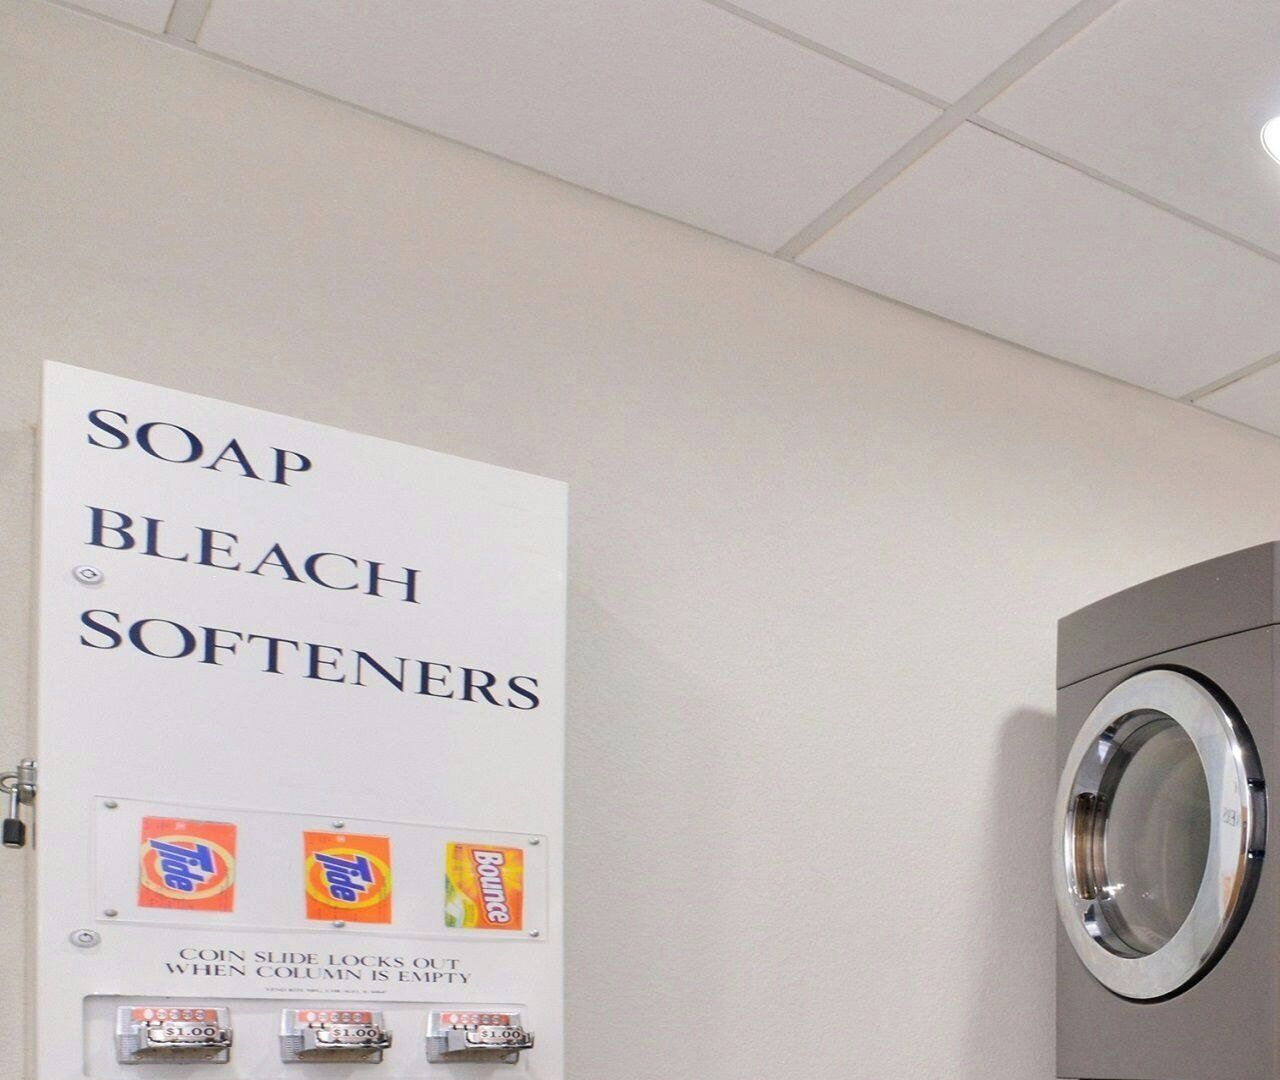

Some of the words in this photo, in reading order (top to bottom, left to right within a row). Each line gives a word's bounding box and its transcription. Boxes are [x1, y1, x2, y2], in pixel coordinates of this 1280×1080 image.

[87, 408, 313, 487] SOAP
[83, 505, 422, 605] BLEACH
[79, 609, 542, 711] SOFTENERS
[149, 838, 215, 892] Tide
[314, 852, 373, 902] Tide
[473, 849, 511, 923] Bounce
[165, 963, 246, 977] WHEN
[255, 966, 362, 981] COLUMN
[372, 970, 388, 982] IS
[399, 971, 472, 985] EMPTY
[179, 948, 246, 963] COIN
[255, 951, 320, 965] SLIDE
[328, 954, 404, 968] LOCKS
[413, 957, 460, 970] OUT
[166, 1027, 216, 1038] $1.00
[333, 1029, 377, 1039] $1.00
[481, 1030, 521, 1040] $1.00
